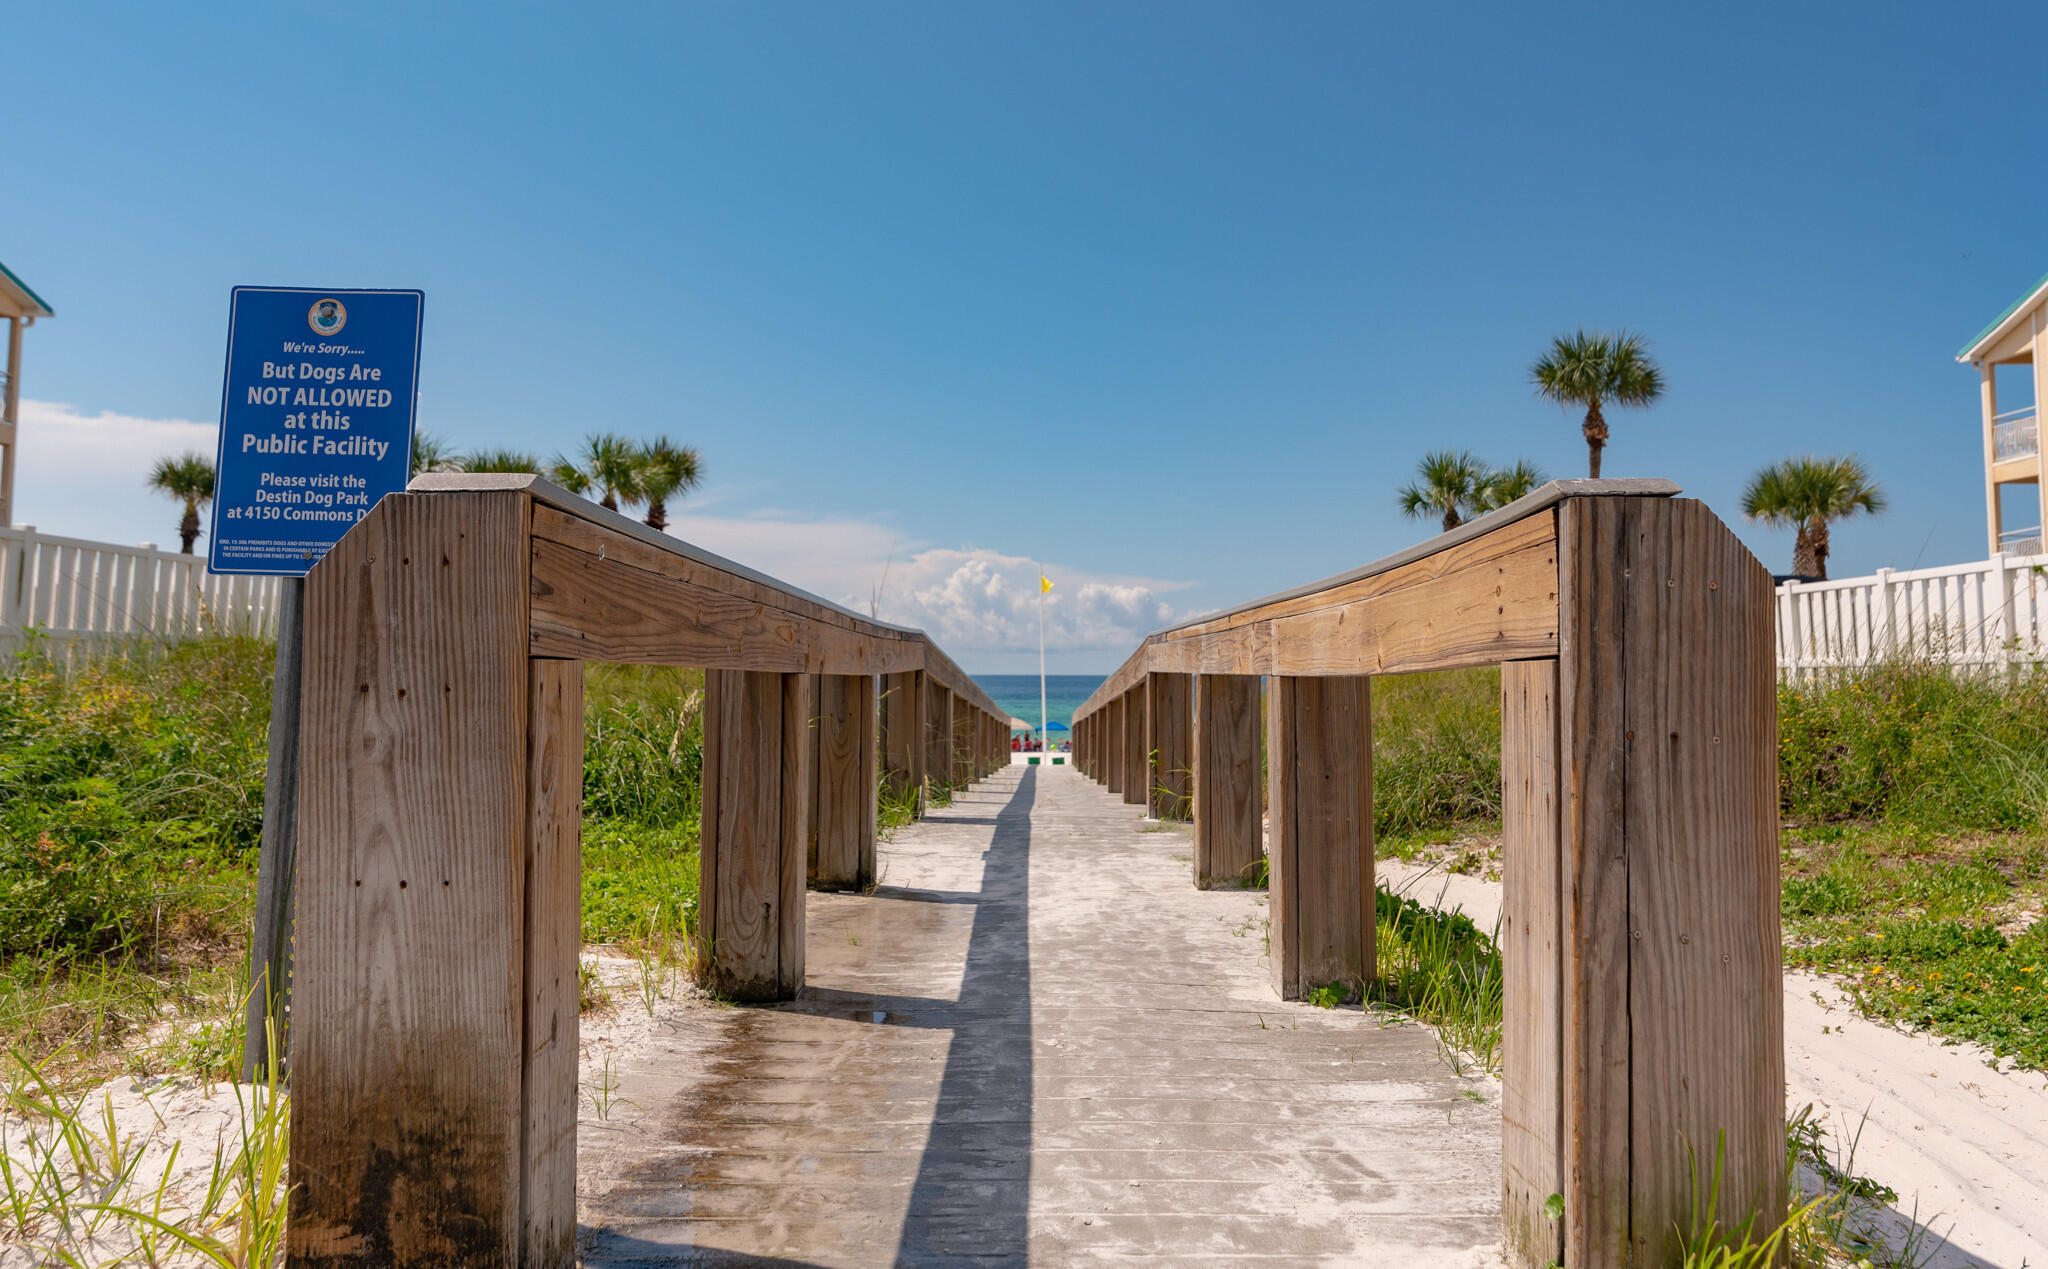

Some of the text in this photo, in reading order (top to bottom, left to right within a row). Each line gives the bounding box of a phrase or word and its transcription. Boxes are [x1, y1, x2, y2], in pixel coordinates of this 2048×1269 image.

[283, 341, 316, 353] We're
[262, 361, 382, 385] But Dogs Are
[247, 386, 392, 408] NOT ALLOWED
[284, 410, 350, 430] at this
[242, 433, 389, 461] Public Facility
[260, 472, 367, 488] Please visit the
[255, 489, 368, 508] Destin Dog Park
[226, 507, 242, 519] at
[244, 506, 281, 520] 4150
[283, 507, 353, 521] Commons
